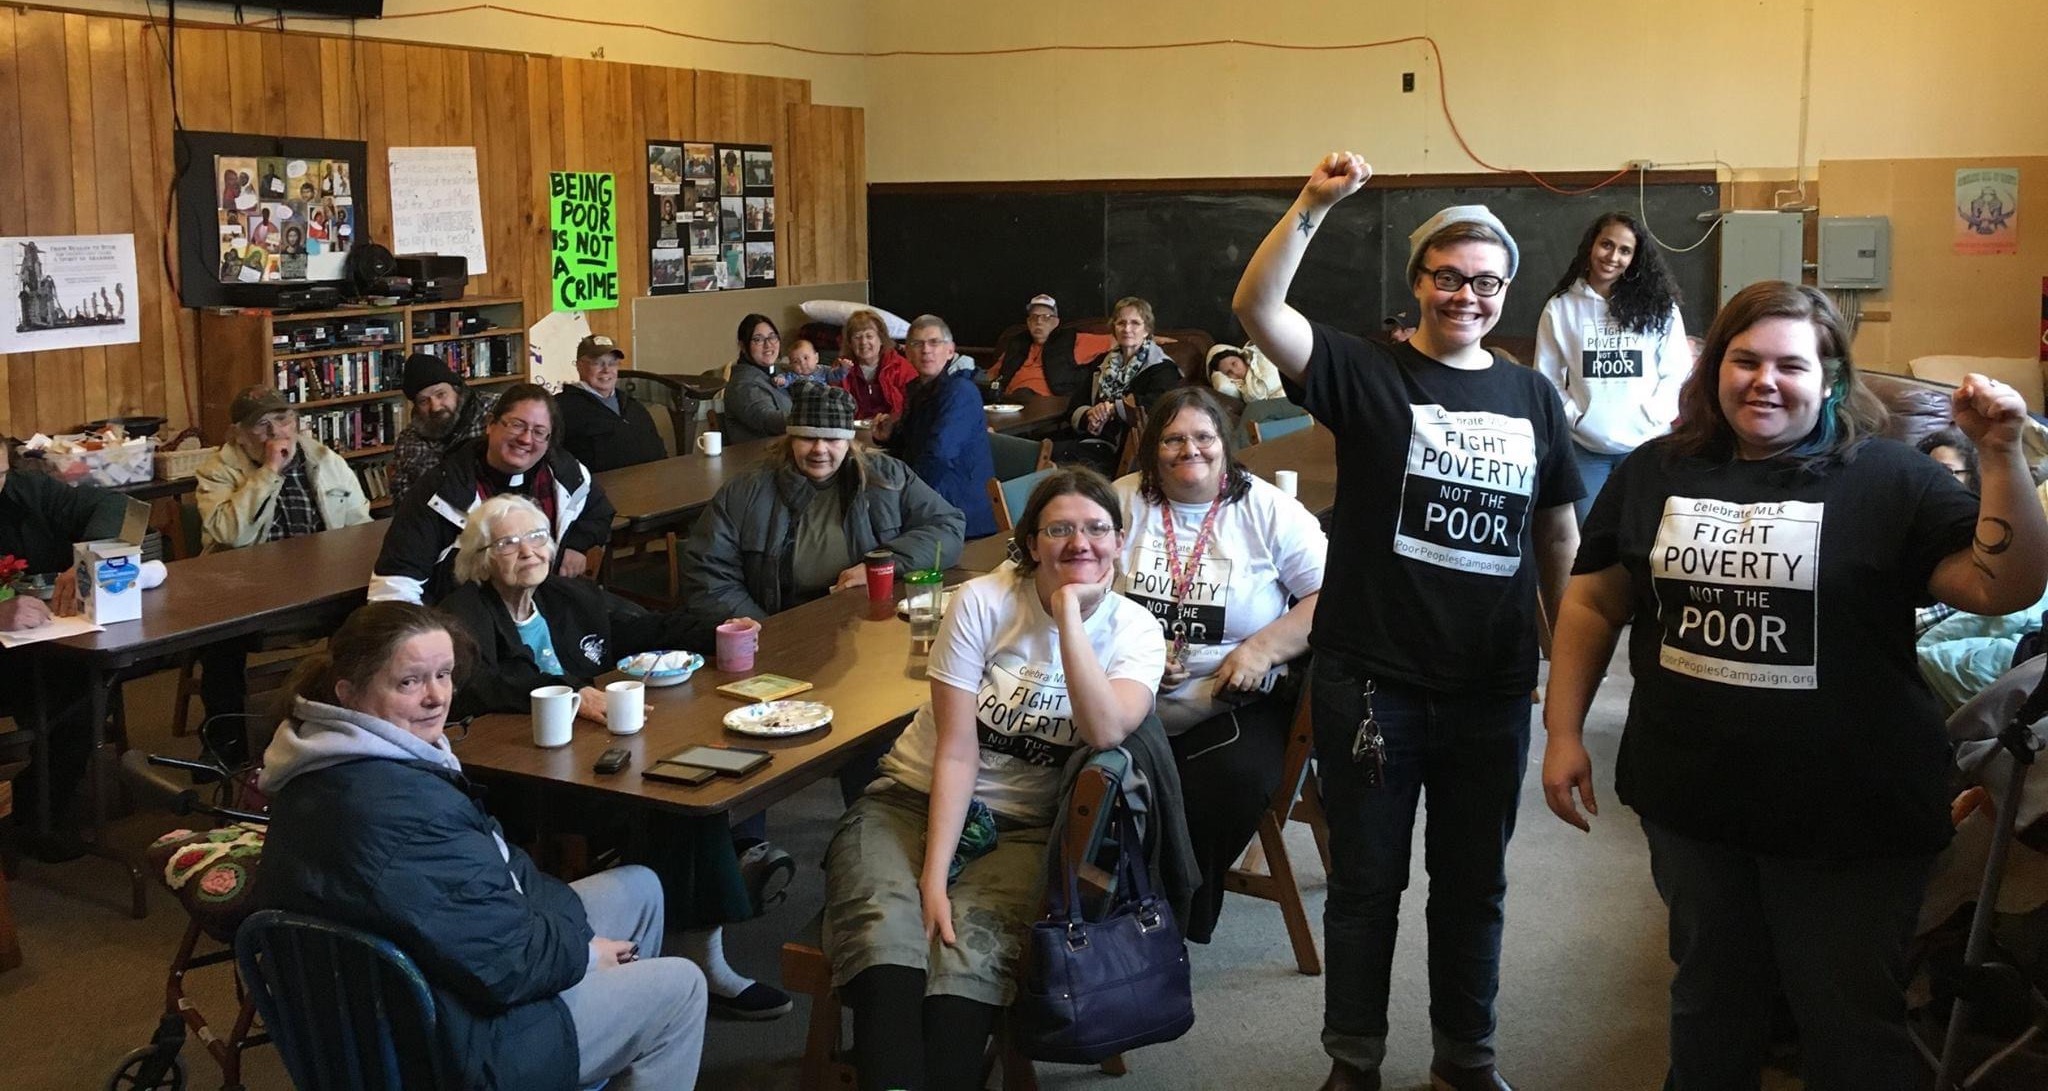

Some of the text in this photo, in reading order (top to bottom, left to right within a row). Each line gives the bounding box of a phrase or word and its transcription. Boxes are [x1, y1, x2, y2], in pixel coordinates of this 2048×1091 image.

[551, 172, 612, 207] BEING
[560, 200, 611, 233] POOR
[552, 230, 613, 260] IS NOT
[553, 256, 569, 279] A
[560, 272, 618, 308] CRIME
[1592, 360, 1634, 375] POOR
[1445, 431, 1507, 455] FIGHT
[1421, 447, 1528, 489] POVERTY
[1439, 485, 1507, 510] NOT THE
[1693, 502, 1786, 519] Celebrate MLK
[1424, 502, 1509, 547] POOR
[1693, 523, 1774, 544] FIGHT
[1154, 557, 1206, 577] FIT
[1664, 546, 1803, 582] POVERTY
[1133, 571, 1220, 601] POVERTY
[1689, 585, 1770, 608] NOT THE
[1146, 600, 1170, 614] NOT
[1678, 606, 1788, 654] POOR
[1010, 686, 1067, 710] FIGHT
[979, 694, 1078, 741] POVERTY
[987, 732, 1015, 746] NOT
